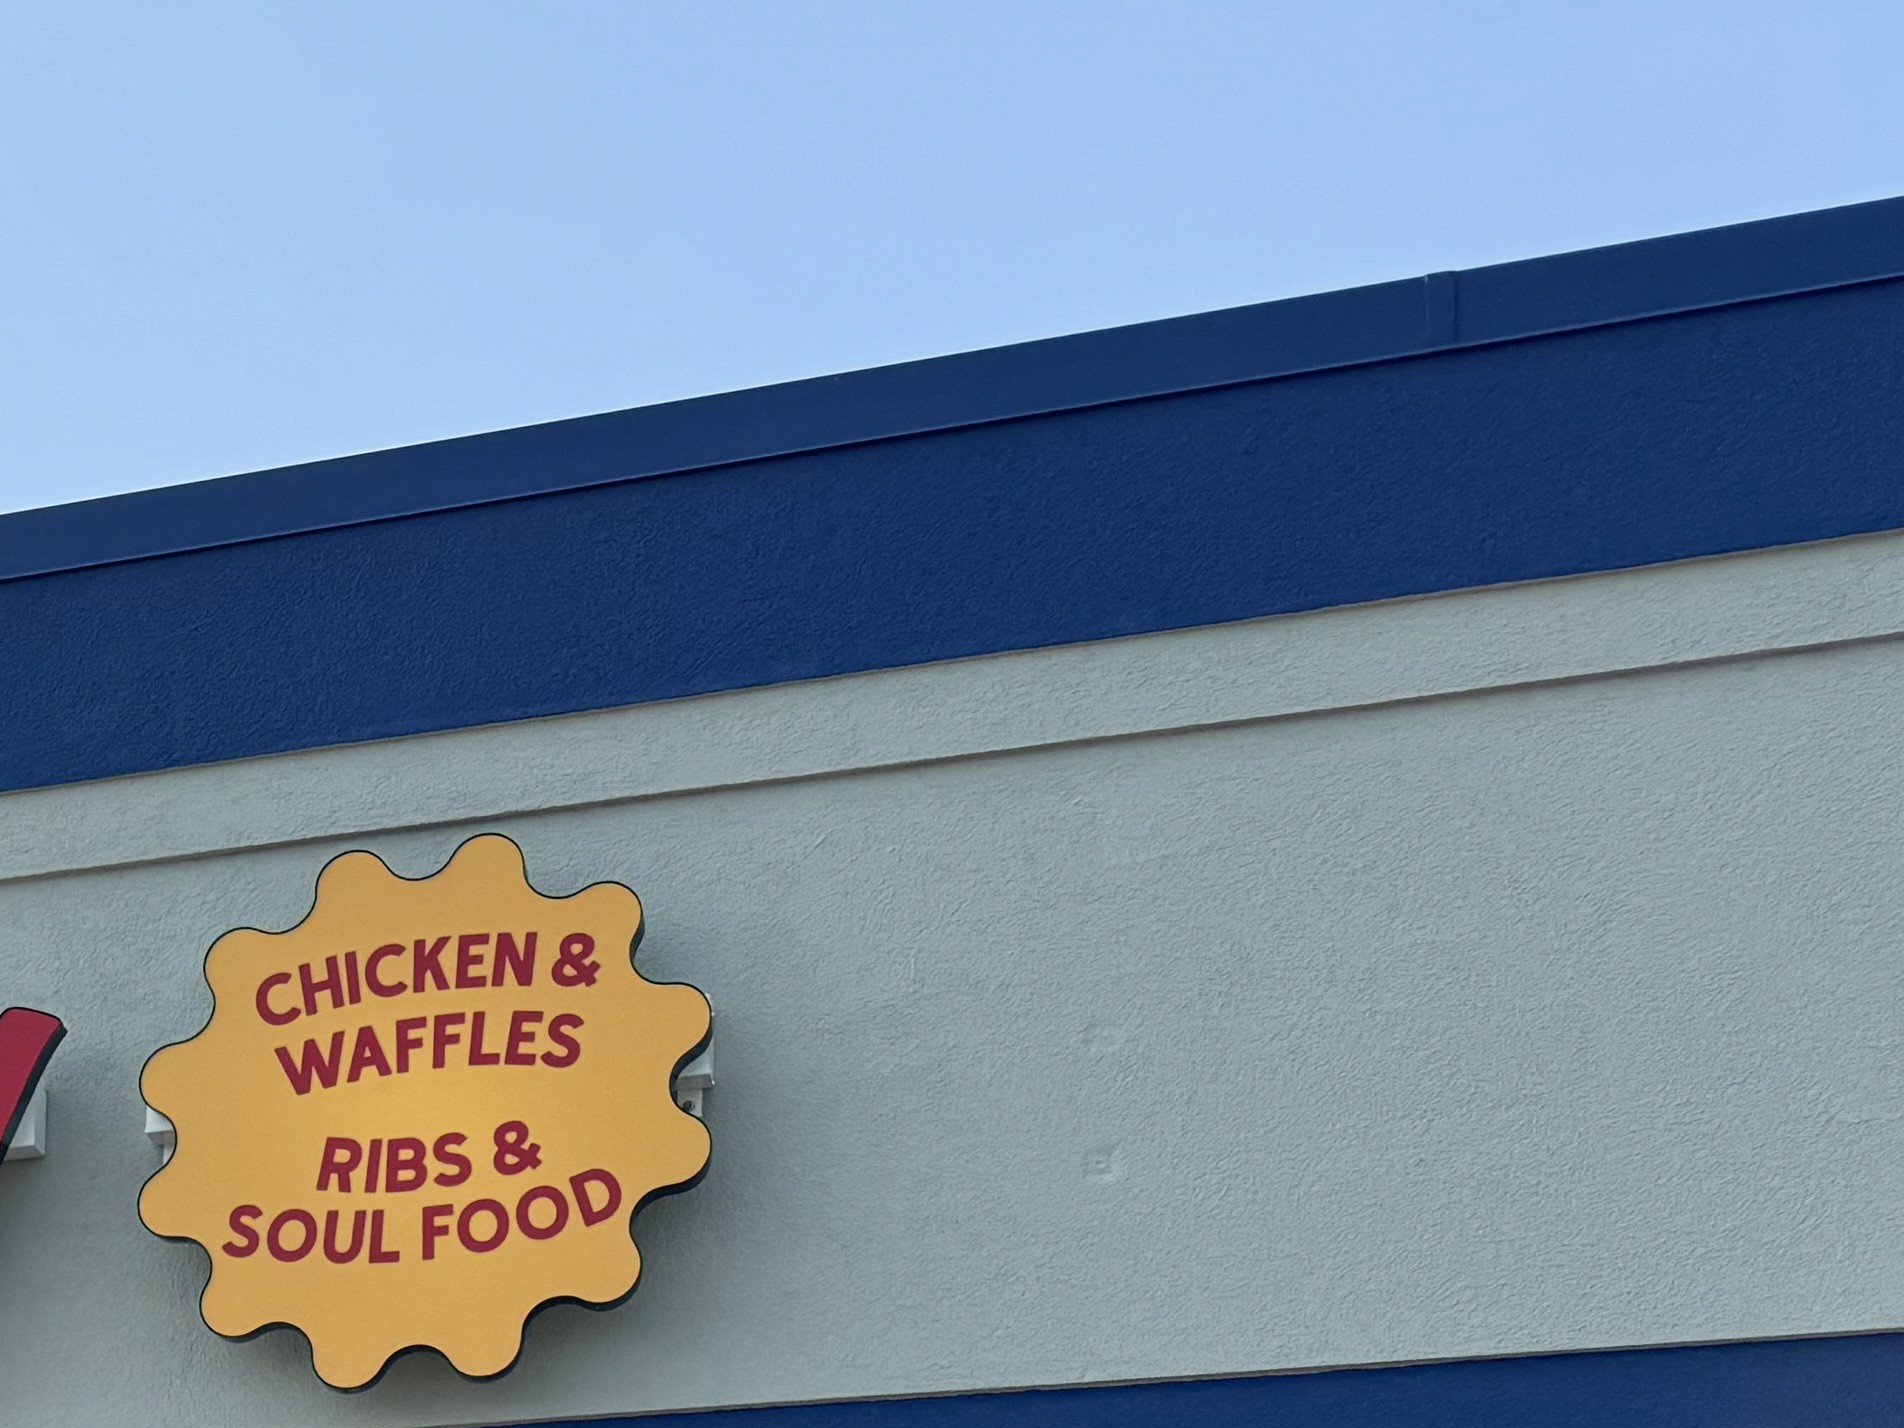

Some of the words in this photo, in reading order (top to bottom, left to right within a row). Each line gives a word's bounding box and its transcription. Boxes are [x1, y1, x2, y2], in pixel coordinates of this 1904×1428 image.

[255, 932, 538, 1026] CHICKEN
[551, 933, 601, 987] &
[275, 1010, 585, 1095] WAFFLES
[316, 1132, 472, 1194] RIBS
[493, 1120, 542, 1176] &
[222, 1205, 399, 1264] SOUL
[422, 1167, 622, 1261] FOOD
